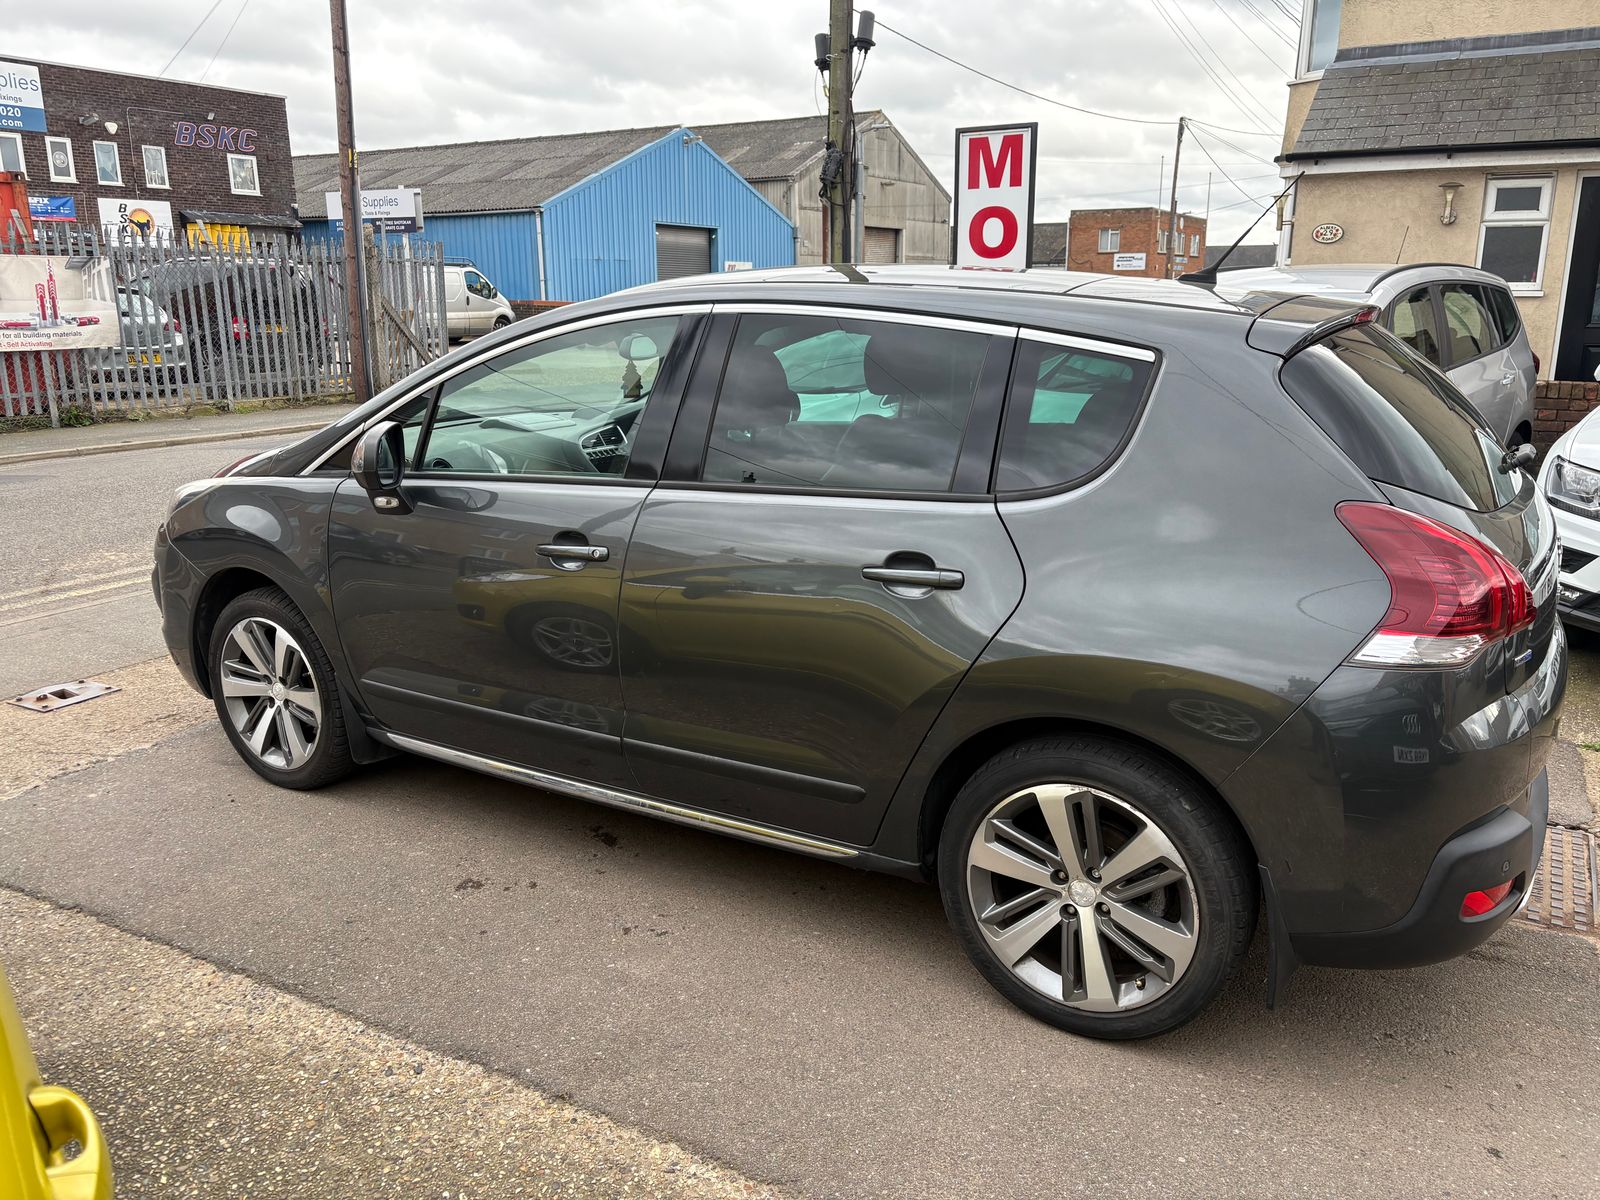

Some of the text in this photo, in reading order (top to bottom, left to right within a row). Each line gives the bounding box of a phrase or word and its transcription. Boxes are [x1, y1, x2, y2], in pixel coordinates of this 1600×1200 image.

[175, 121, 257, 152] BSKC
[362, 195, 399, 209] Supplies
[22, 331, 51, 339] building
[52, 330, 82, 338] materials
